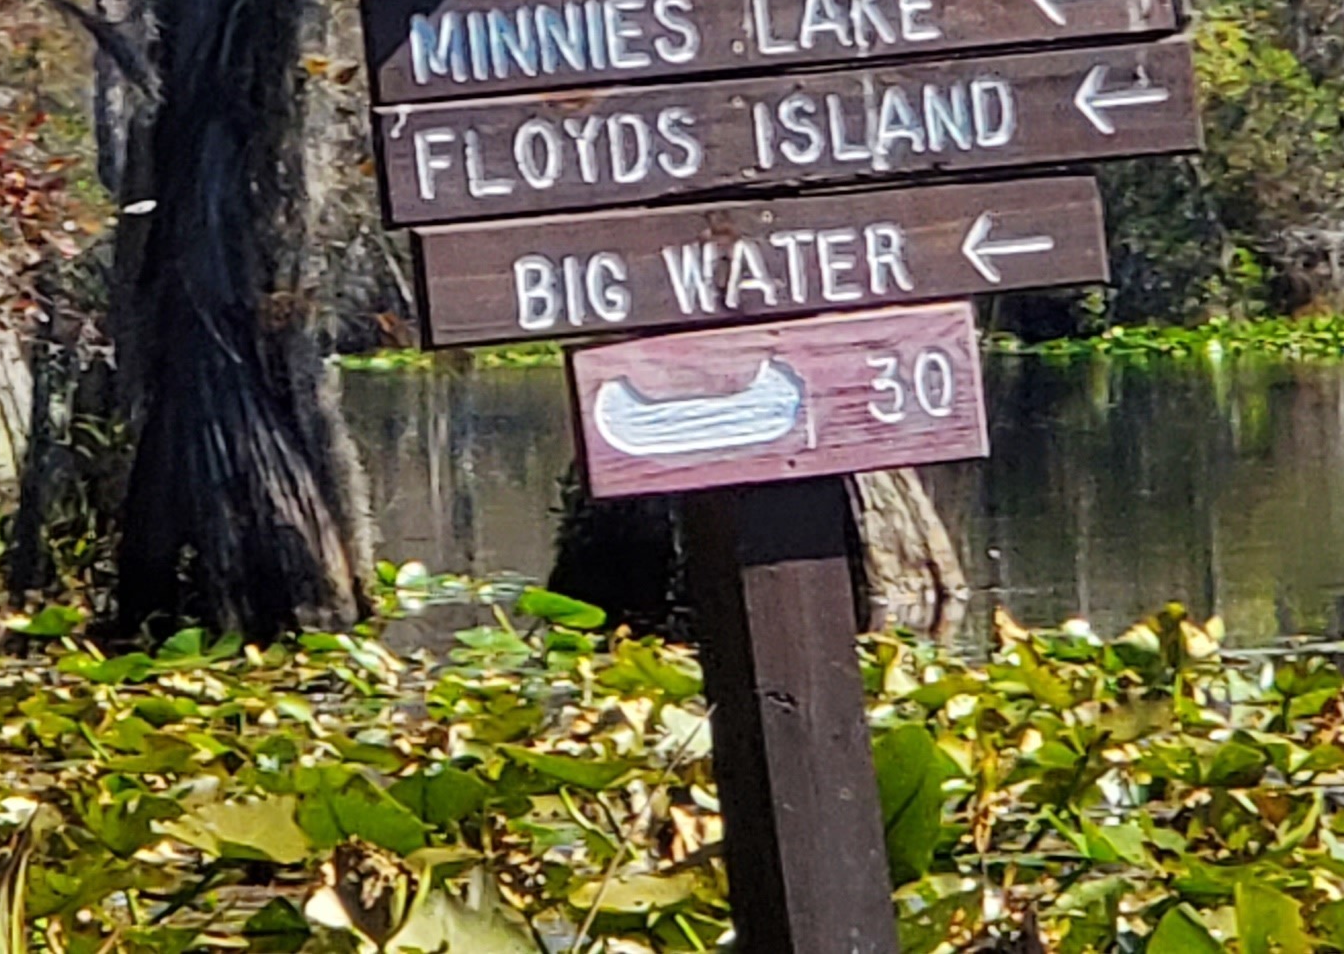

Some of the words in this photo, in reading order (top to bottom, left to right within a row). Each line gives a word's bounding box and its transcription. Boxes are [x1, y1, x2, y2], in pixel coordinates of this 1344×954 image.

[413, 105, 704, 201] FLOYDS
[753, 75, 1016, 170] ISLAND
[512, 252, 630, 332] BIG
[660, 221, 915, 315] WATER
[865, 350, 955, 424] 30
